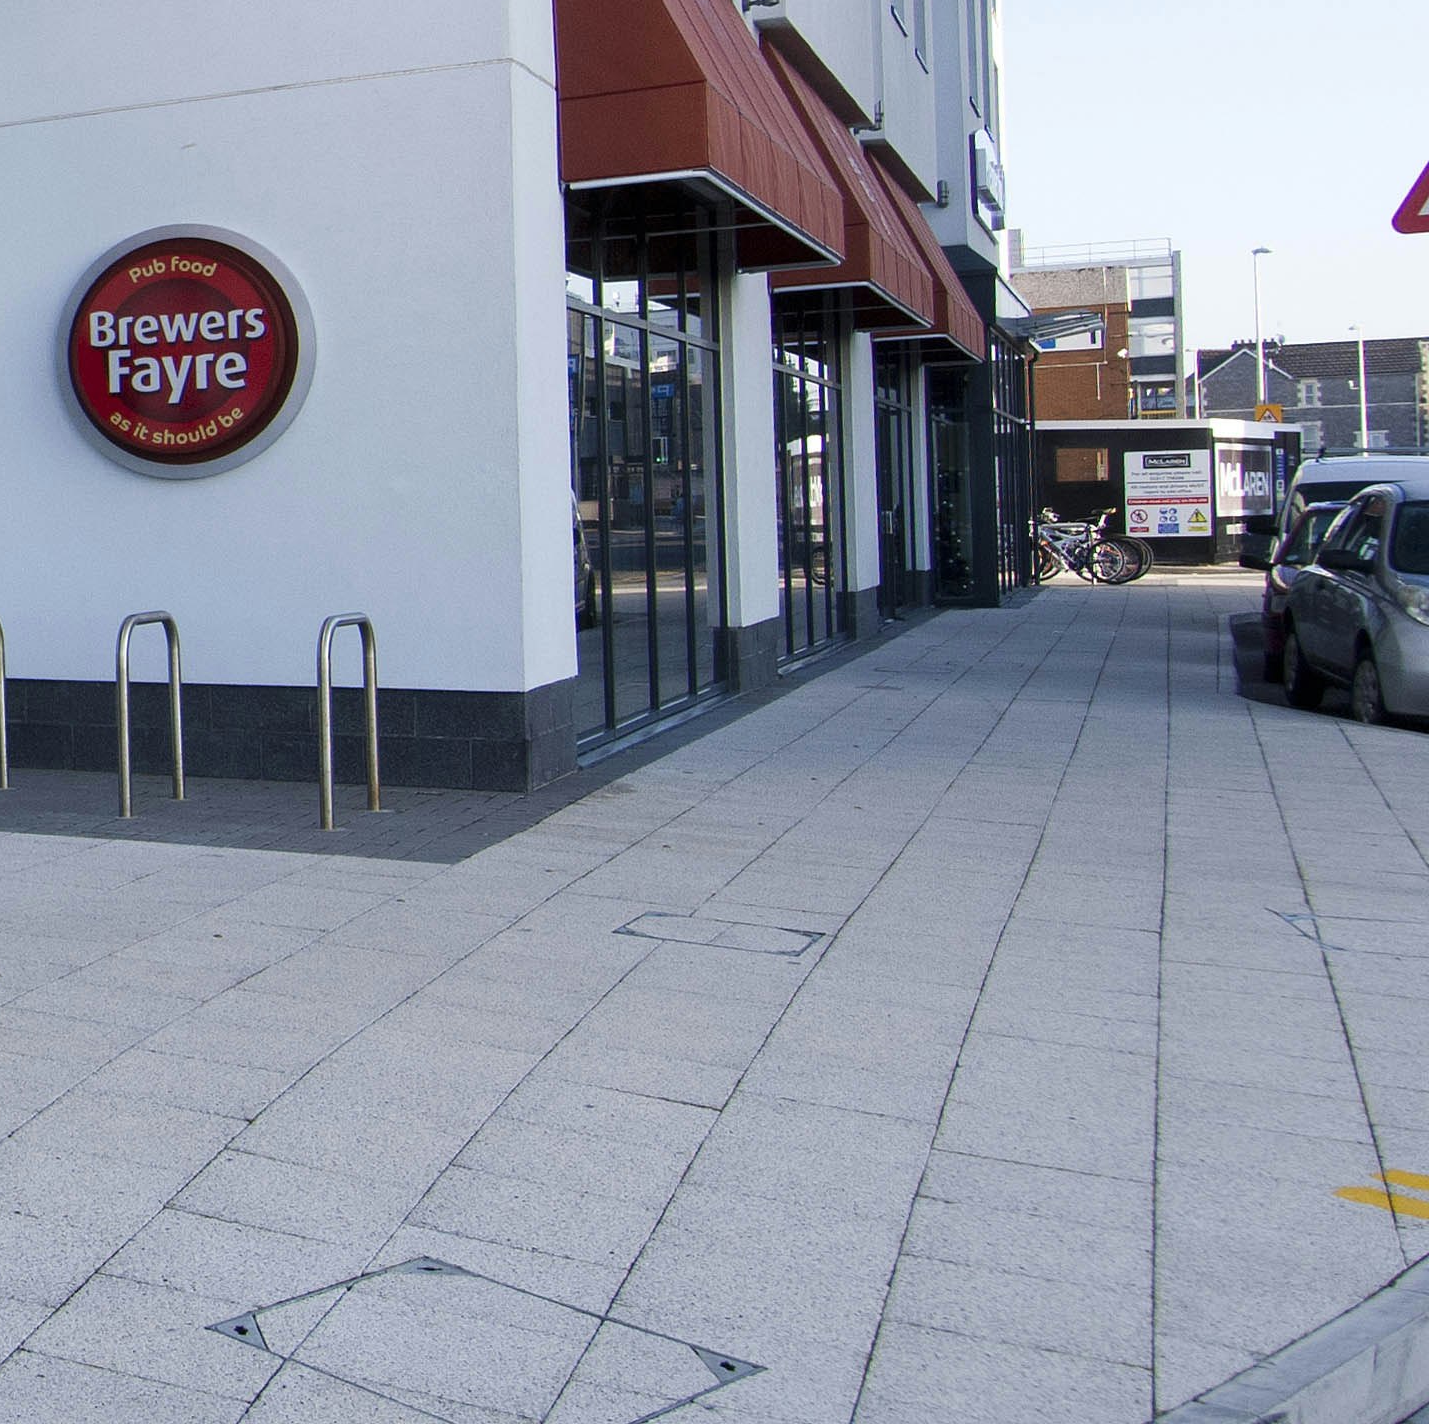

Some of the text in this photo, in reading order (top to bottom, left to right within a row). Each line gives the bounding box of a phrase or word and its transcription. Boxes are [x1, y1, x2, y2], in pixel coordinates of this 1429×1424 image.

[170, 256, 218, 277] food
[89, 308, 266, 347] Brewers
[107, 349, 248, 404] Fayre
[109, 407, 244, 445] as it should be
